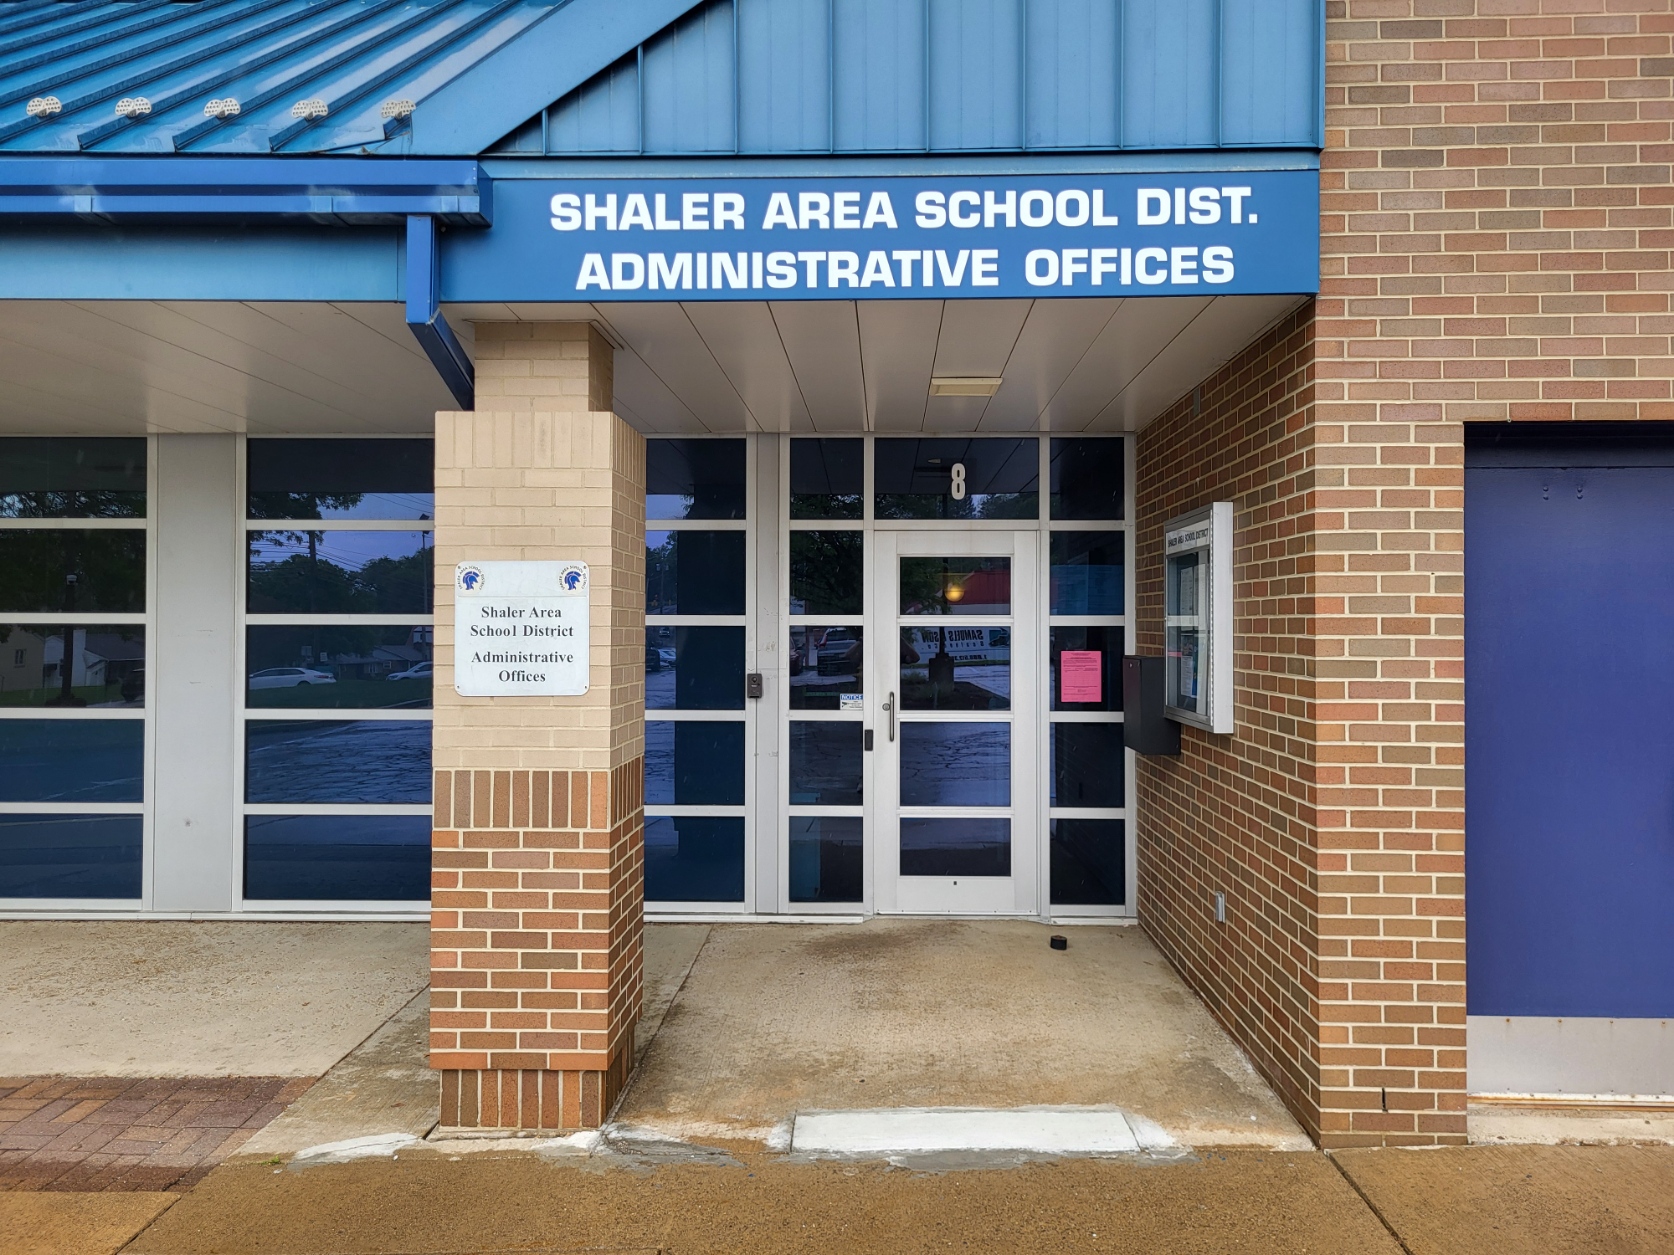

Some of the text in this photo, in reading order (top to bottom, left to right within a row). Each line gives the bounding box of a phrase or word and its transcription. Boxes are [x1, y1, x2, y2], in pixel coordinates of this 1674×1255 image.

[550, 186, 1258, 231] SHALER AREA SCHOOL DIST.
[575, 246, 1235, 291] ADMINISTRATIVE OFFICES
[952, 463, 965, 500] 8
[1184, 531, 1196, 543] SCHOOL
[481, 606, 562, 618] Shaler Area
[470, 625, 574, 637] School District
[471, 651, 574, 663] Administrative
[498, 670, 546, 682] Offices
